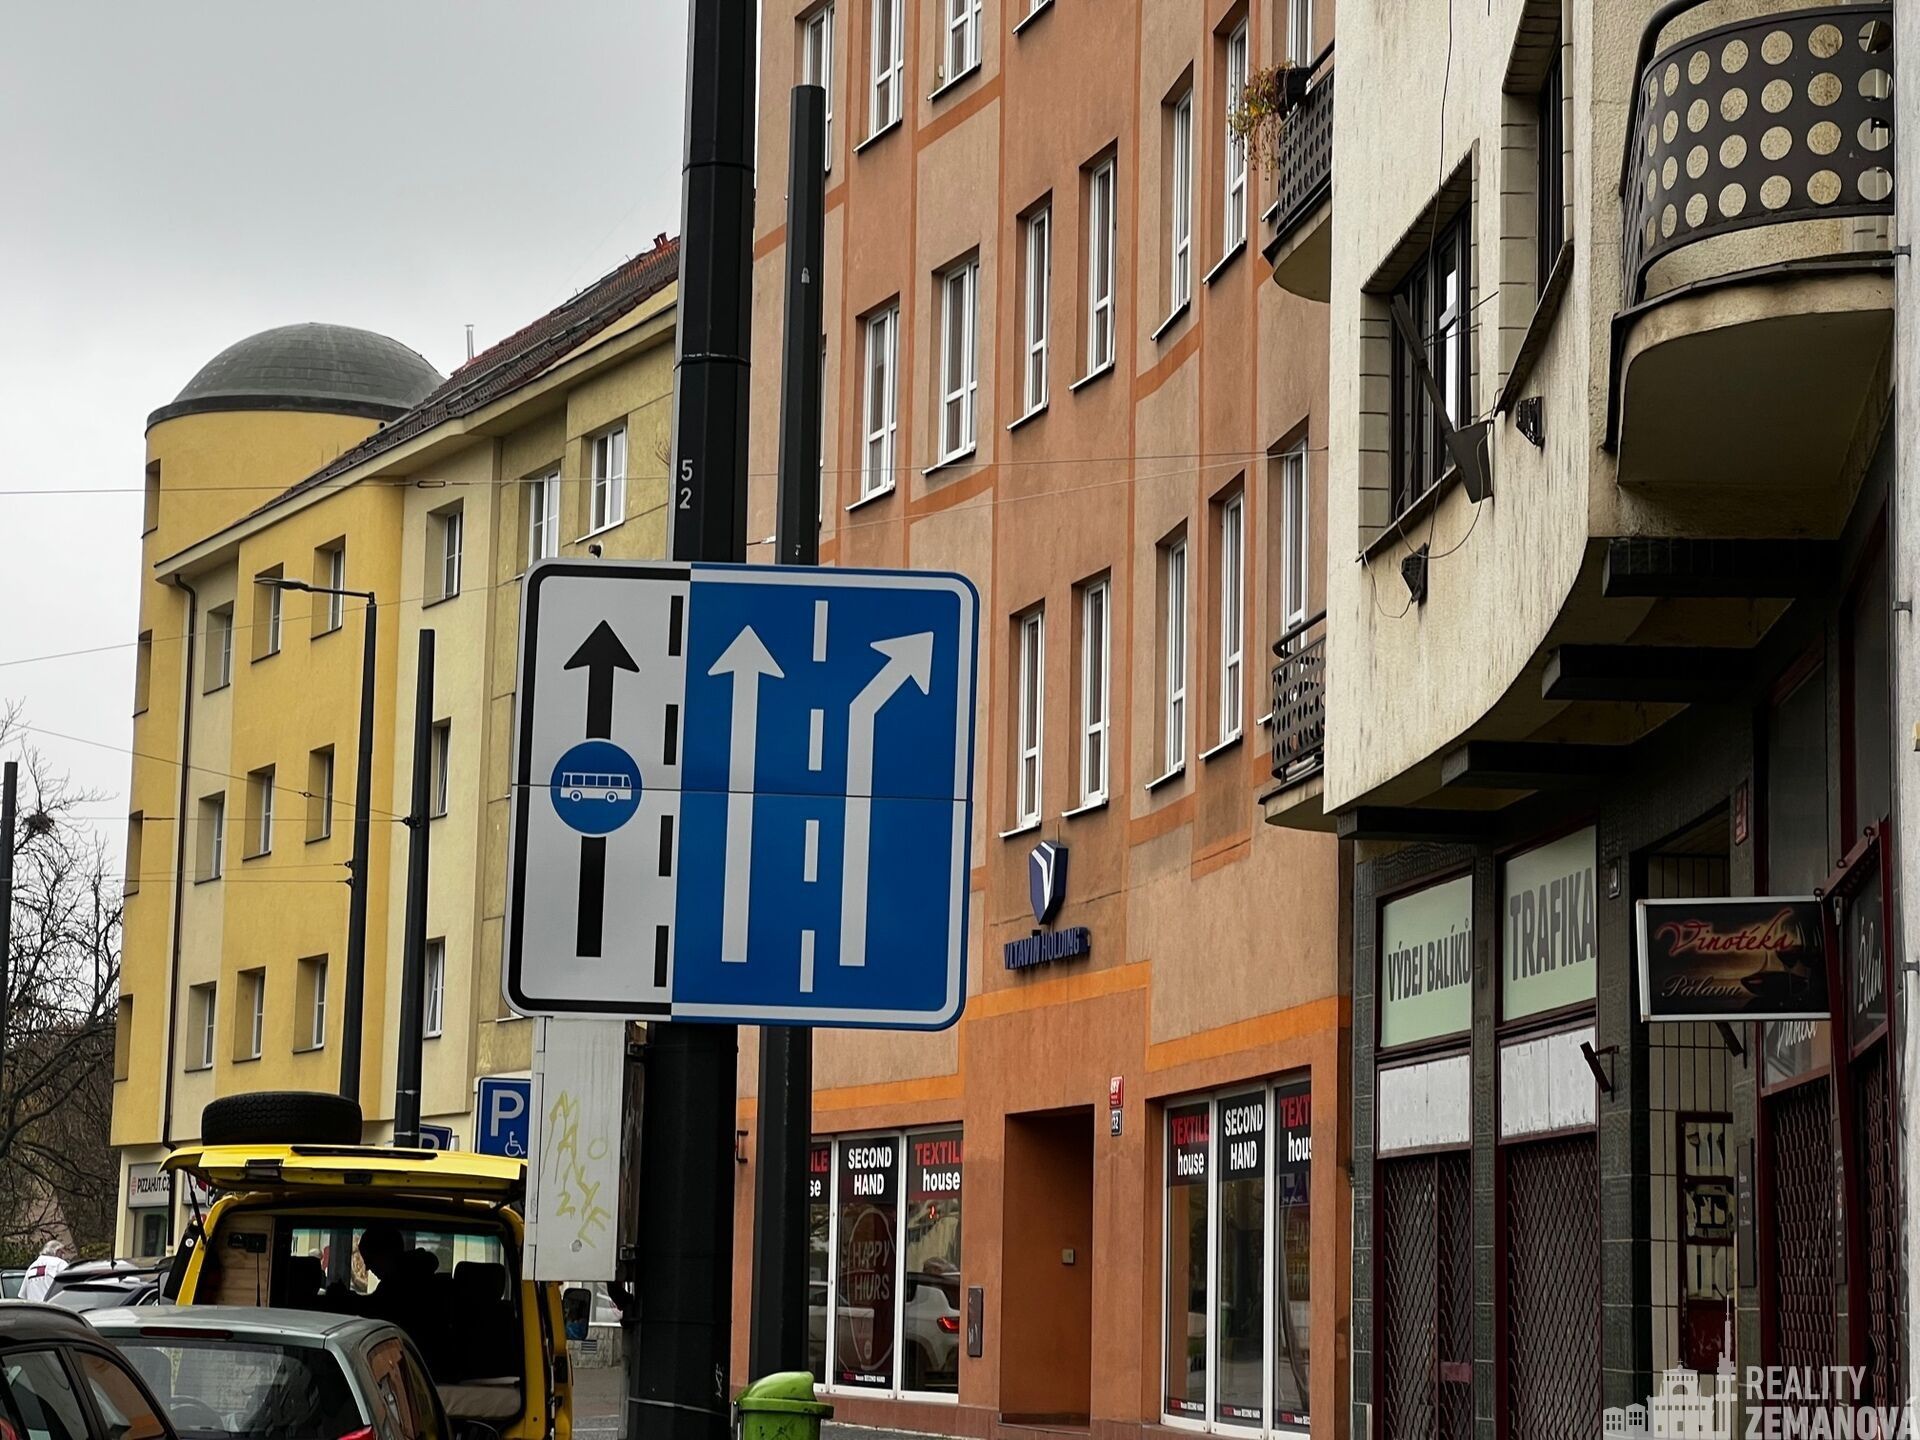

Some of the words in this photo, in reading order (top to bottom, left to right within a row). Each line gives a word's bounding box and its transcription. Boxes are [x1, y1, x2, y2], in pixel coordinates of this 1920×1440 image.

[1510, 867, 1597, 982] TRAFIKA
[1656, 907, 1795, 957] Vinotéka
[1041, 926, 1081, 964] HOLDING
[1388, 940, 1423, 1002] VÝDEJ
[1427, 917, 1472, 993] BALÍKŮ
[1661, 975, 1744, 999] Pálava
[490, 1089, 525, 1137] P
[1225, 1104, 1264, 1137] SECOND
[848, 1146, 892, 1170] SECOND
[915, 1139, 963, 1166] TEXTIL
[1177, 1149, 1205, 1176] house
[1230, 1140, 1257, 1171] HAND
[853, 1174, 885, 1196] HAND
[922, 1168, 960, 1192] house
